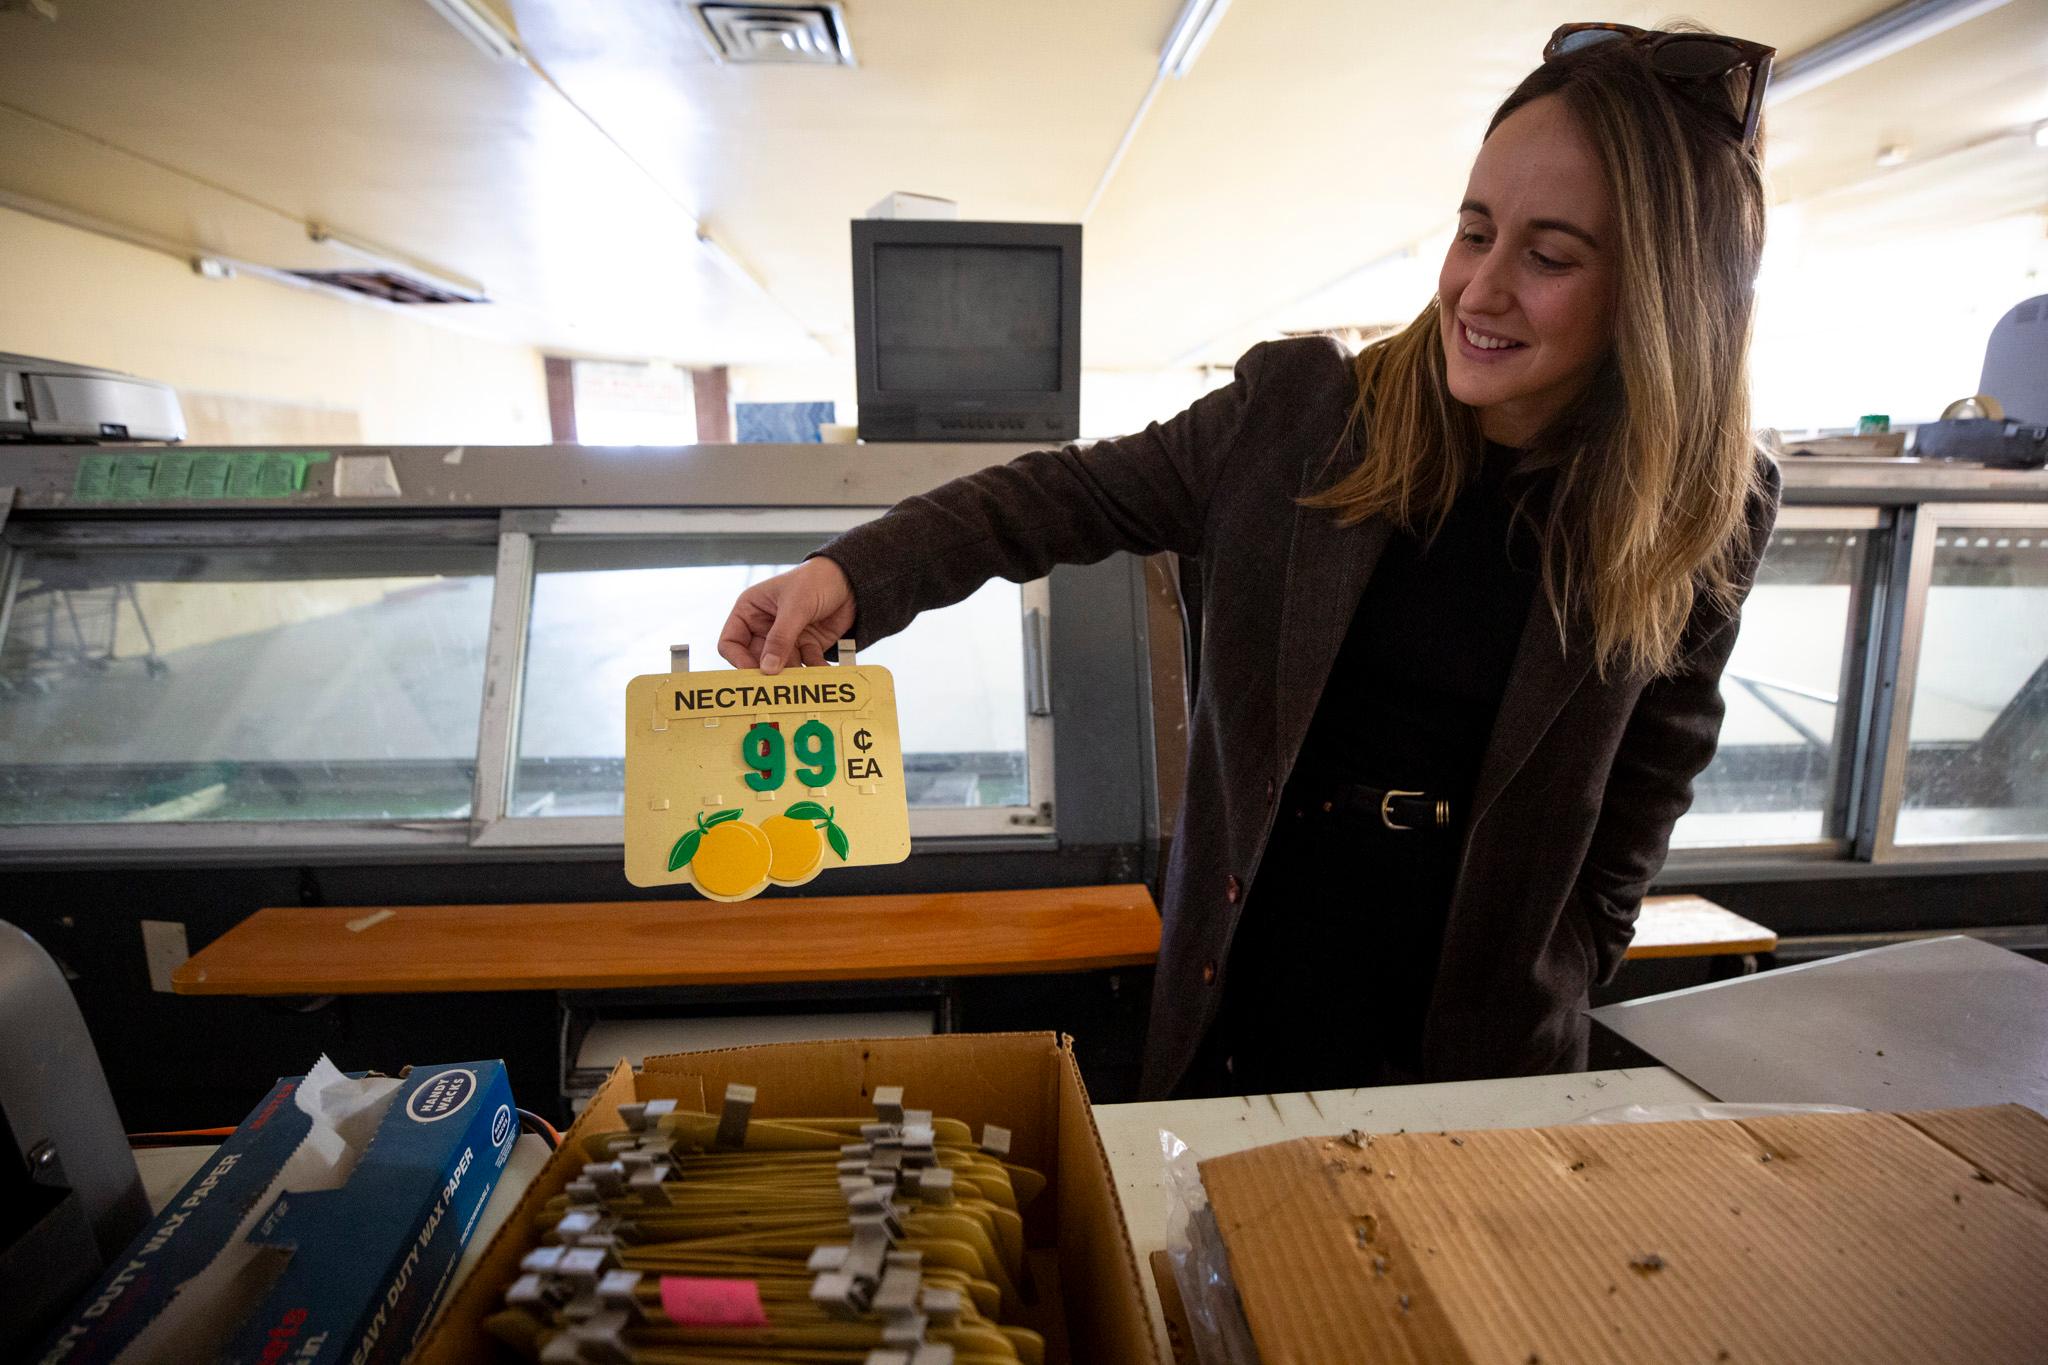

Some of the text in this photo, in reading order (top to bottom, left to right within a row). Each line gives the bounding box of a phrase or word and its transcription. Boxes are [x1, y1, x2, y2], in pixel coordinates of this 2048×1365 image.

[674, 683, 856, 711] NECTARINES
[742, 720, 837, 792] 99
[847, 758, 883, 779] EA
[420, 1079, 450, 1112] HANDY
[435, 1078, 465, 1112] WACKS
[81, 1260, 147, 1319] DUTY
[138, 1210, 192, 1256] WAX
[181, 1153, 242, 1209] PAPER
[351, 1302, 387, 1365] EAVY
[387, 1243, 420, 1309] DUTY
[418, 1200, 446, 1248] WAX
[442, 1147, 474, 1206] PAPER
